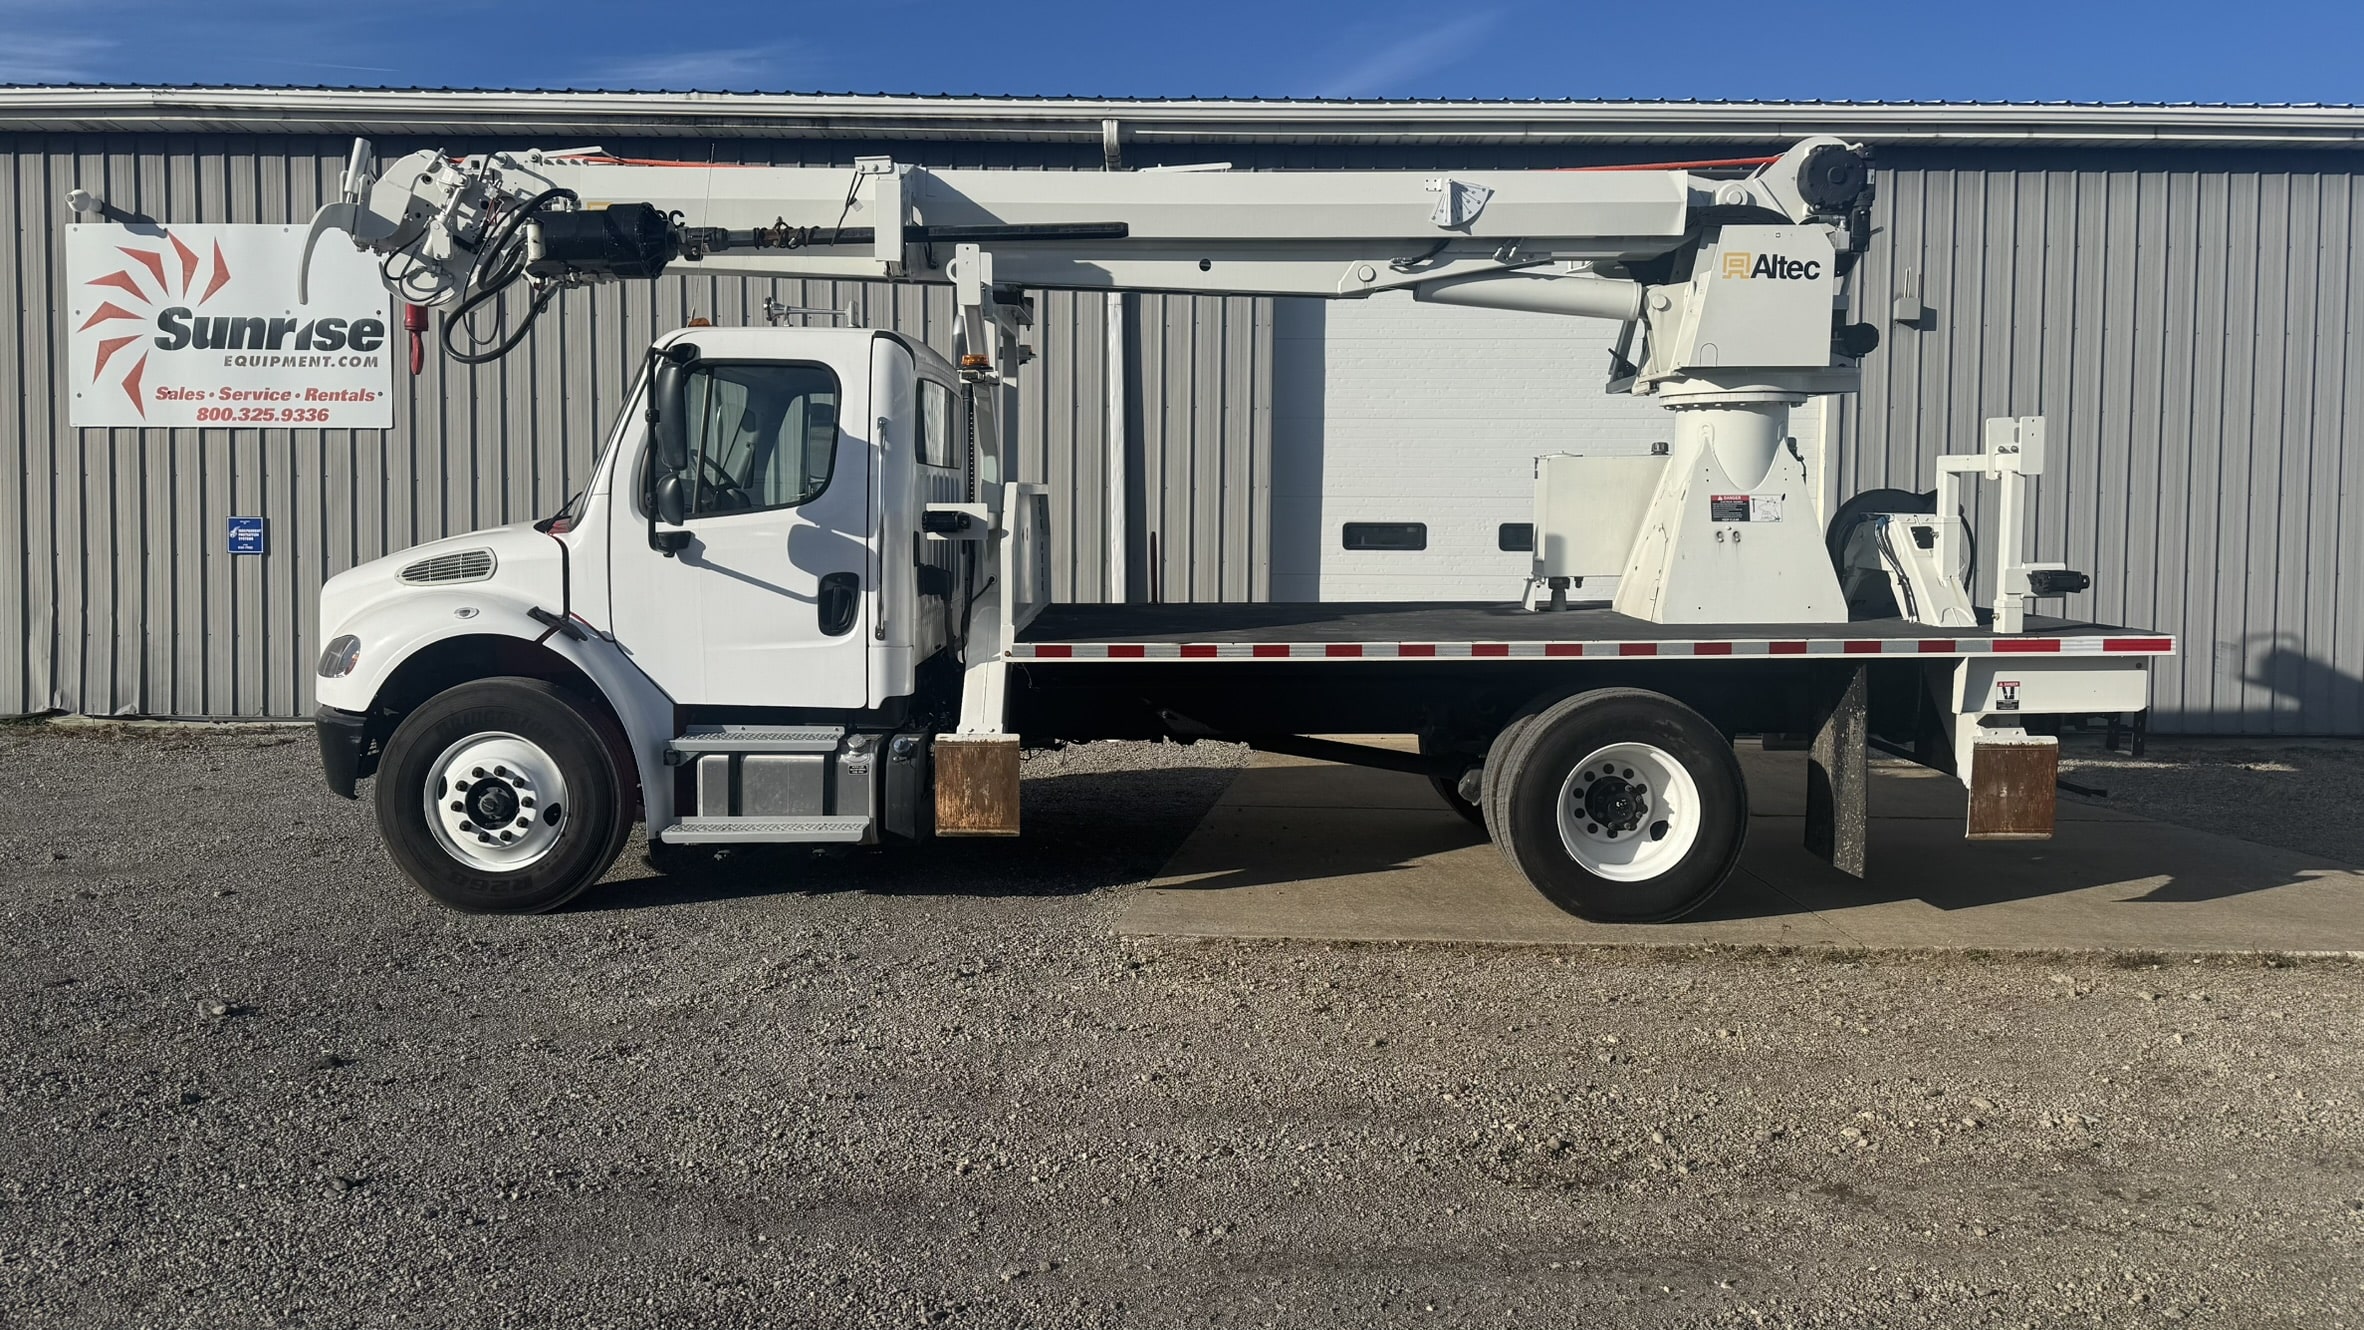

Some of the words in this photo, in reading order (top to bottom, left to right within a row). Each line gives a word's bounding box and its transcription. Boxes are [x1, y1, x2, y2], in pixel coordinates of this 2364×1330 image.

[1750, 253, 1821, 280] Altec
[154, 306, 385, 351] Sunrise
[223, 355, 379, 368] EQUIPMENT.COM
[155, 386, 206, 401] Sales
[218, 386, 292, 401] Service
[304, 387, 375, 402] Rentals
[196, 407, 330, 423] 800.325.9336
